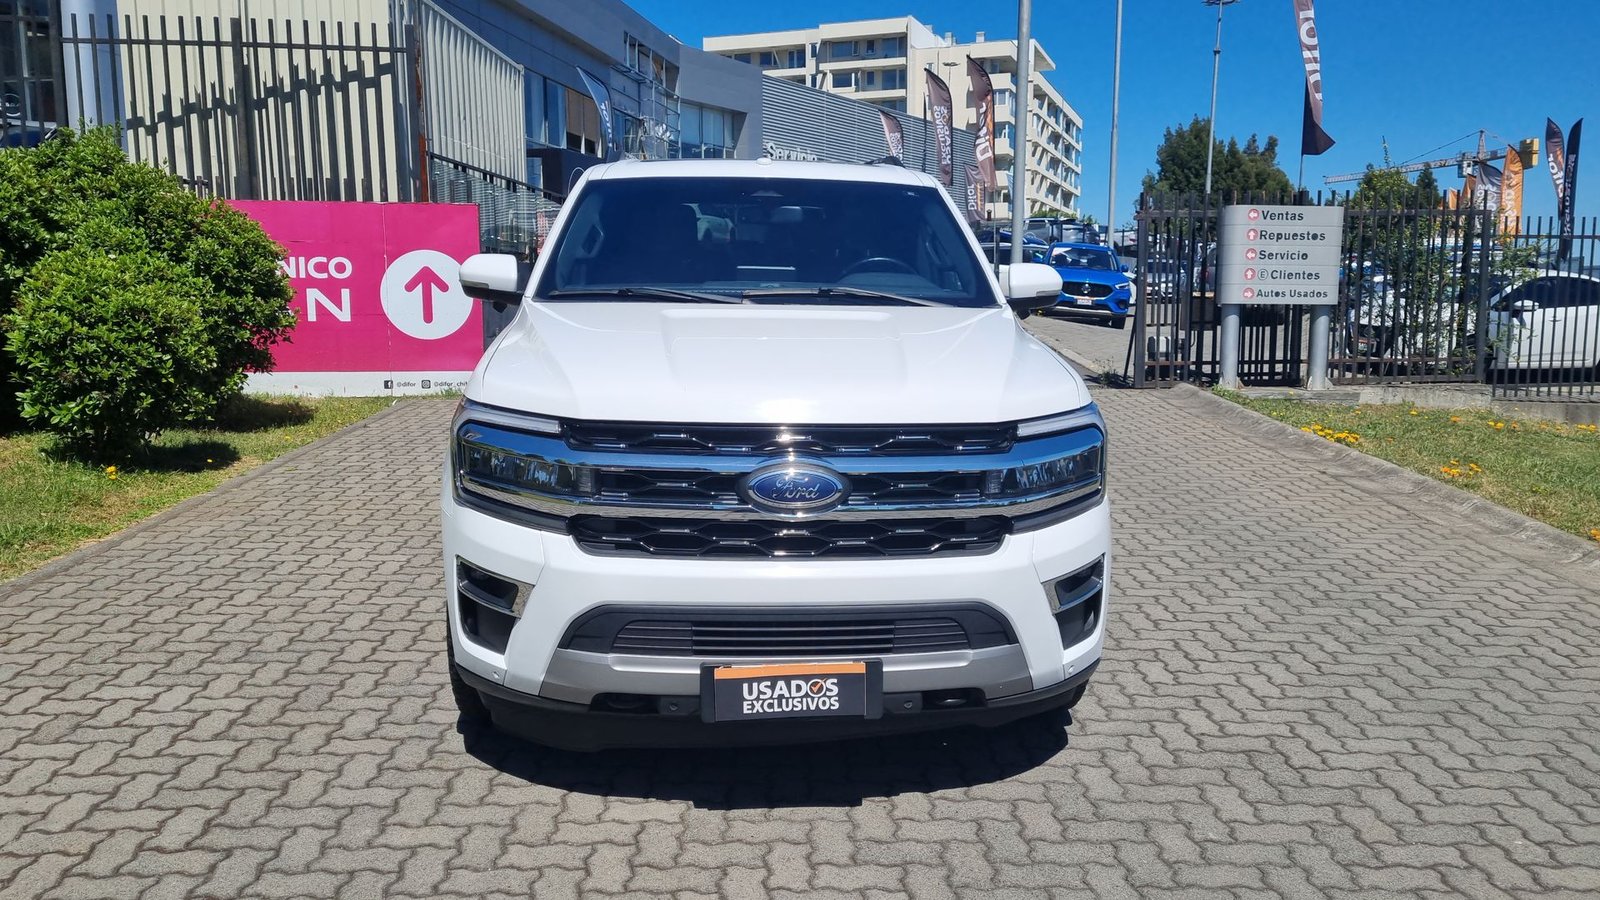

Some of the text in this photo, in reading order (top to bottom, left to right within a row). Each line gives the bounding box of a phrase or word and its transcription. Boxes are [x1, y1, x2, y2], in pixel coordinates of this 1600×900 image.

[1262, 210, 1304, 221] Ventas
[1259, 230, 1326, 242] Repuestos
[1258, 250, 1308, 260] Servicio
[1270, 270, 1320, 280] Clientes
[1256, 289, 1328, 298] Autos Usados
[772, 474, 821, 499] Ford
[742, 678, 839, 700] USADOS
[743, 697, 839, 714] EXCLUSIVOS
